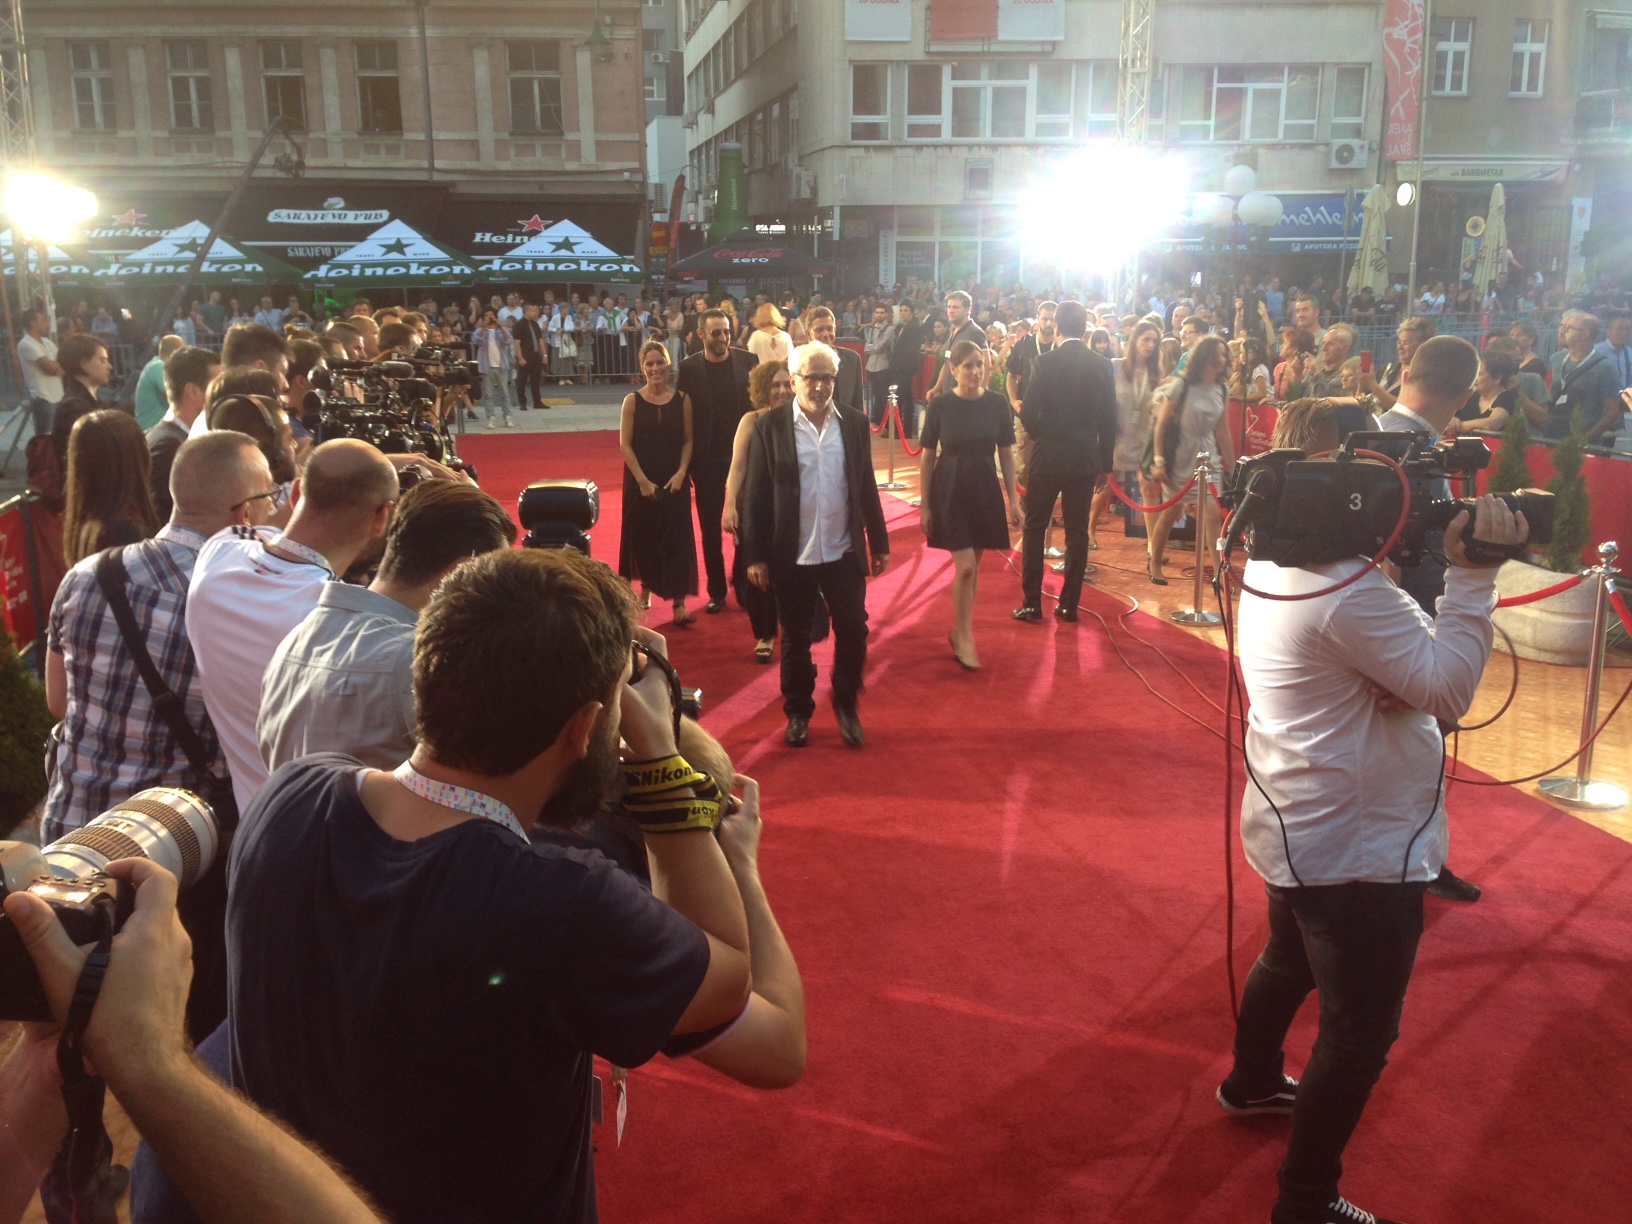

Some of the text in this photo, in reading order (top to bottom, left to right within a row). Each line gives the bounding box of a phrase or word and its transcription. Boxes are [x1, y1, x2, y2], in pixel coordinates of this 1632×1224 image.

[1461, 168, 1504, 177] BAROMETAR
[272, 211, 384, 221] SARAJEVO PUB
[714, 248, 784, 259] Coca-Cola
[1348, 493, 1362, 511] 3
[641, 766, 692, 787] Nikon
